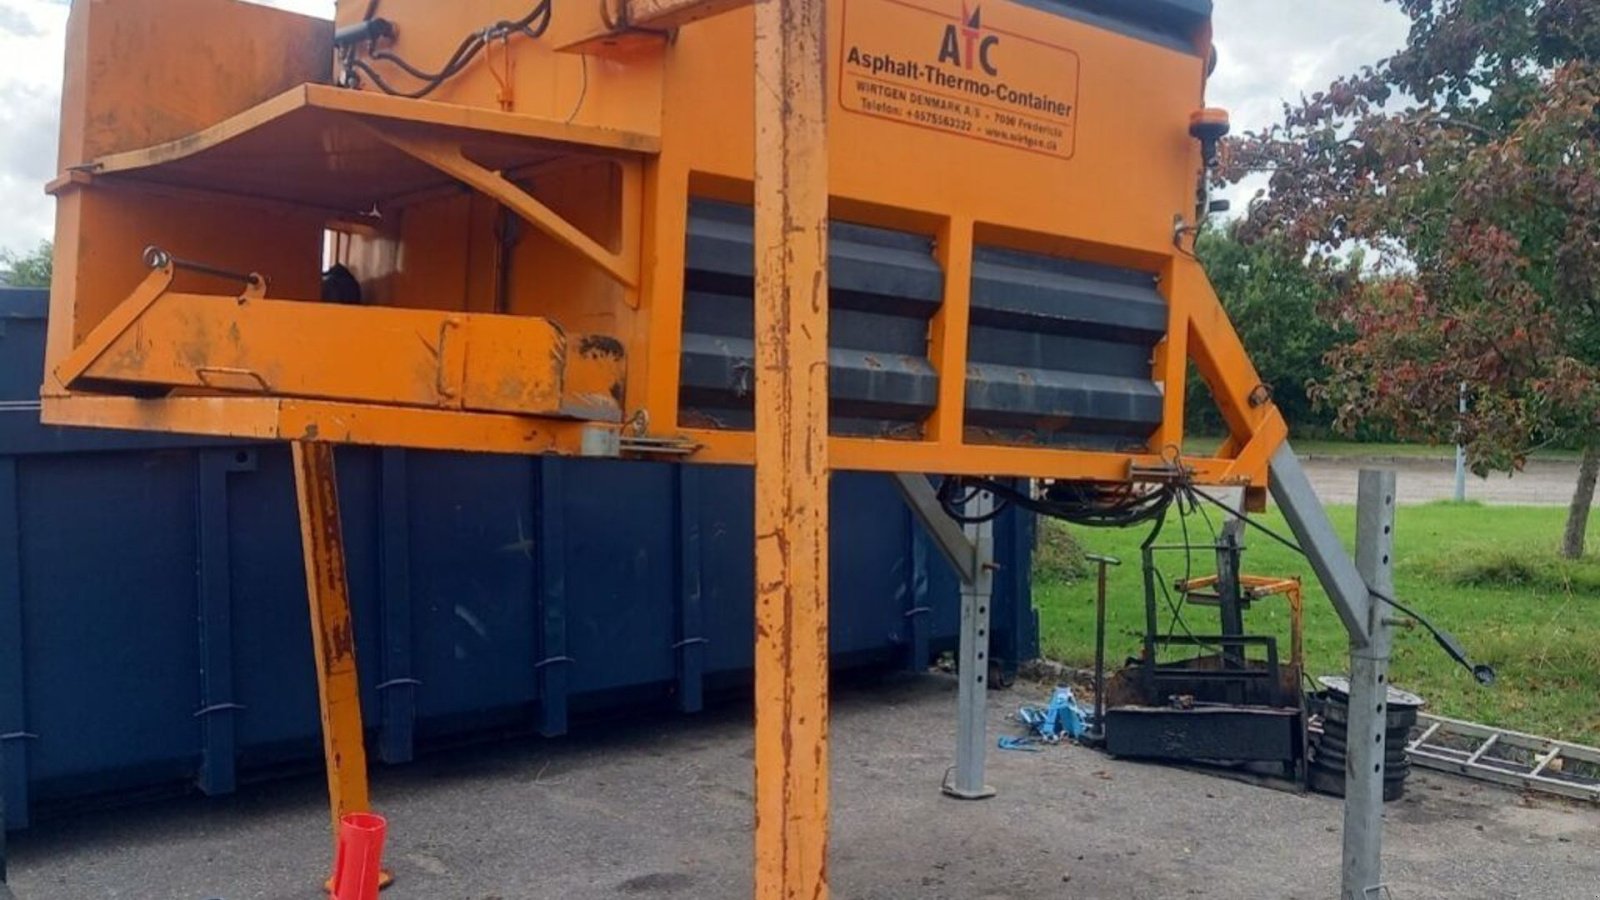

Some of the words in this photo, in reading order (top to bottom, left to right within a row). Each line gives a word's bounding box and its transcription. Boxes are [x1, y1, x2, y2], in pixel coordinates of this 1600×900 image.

[938, 23, 999, 76] ATC
[847, 46, 1072, 118] Asphalt-Thermo-Container
[856, 81, 906, 101] WIRTGEN
[910, 93, 961, 112] DENMARK
[861, 97, 903, 115] Telefon:
